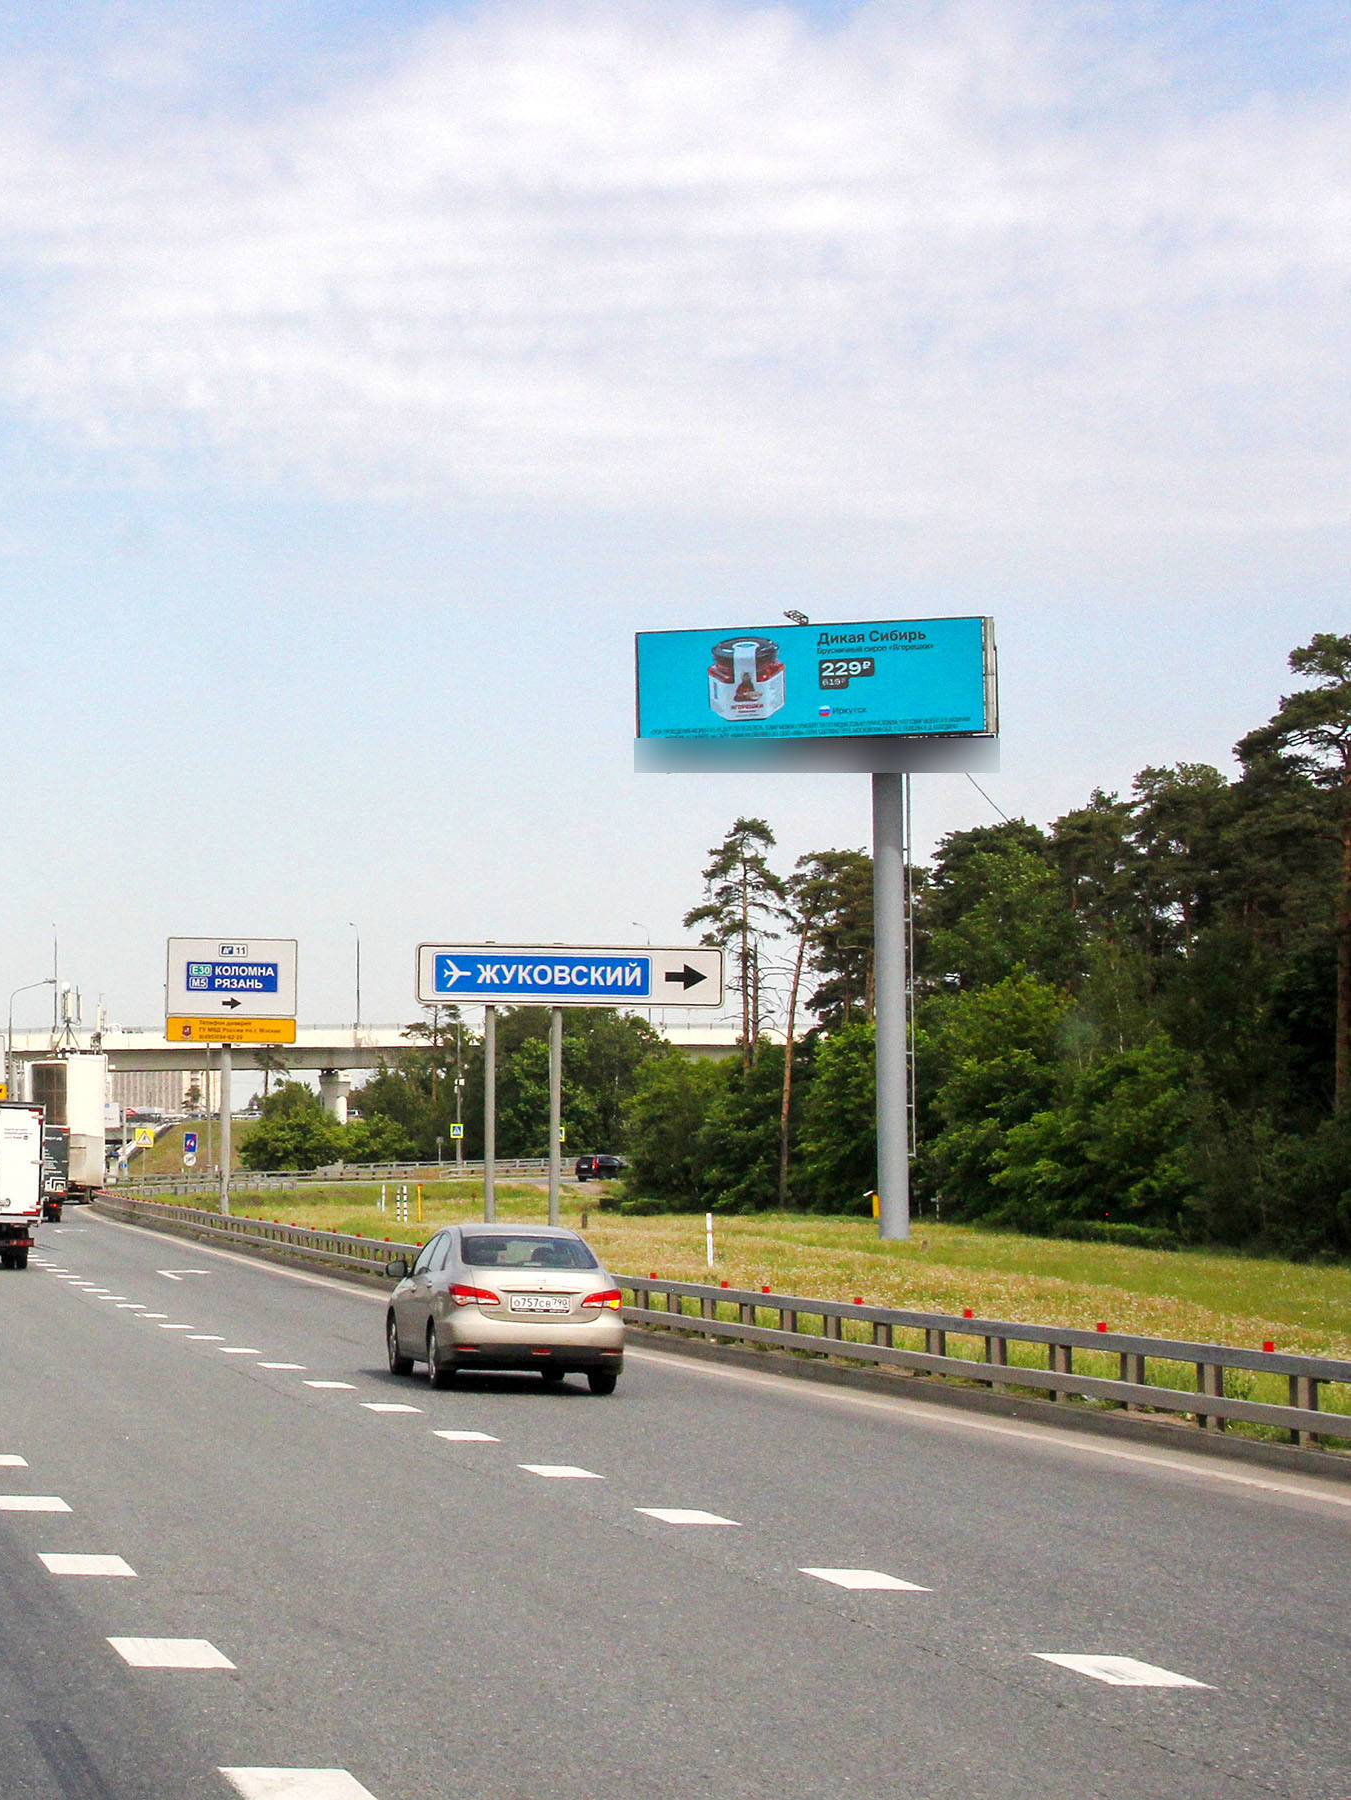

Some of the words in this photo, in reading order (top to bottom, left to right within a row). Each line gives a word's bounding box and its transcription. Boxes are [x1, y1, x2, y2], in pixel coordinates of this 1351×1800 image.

[817, 633, 865, 646] Дикая
[869, 630, 926, 643] Сибирь
[832, 706, 867, 715] Иркутск
[236, 946, 246, 955] 11
[192, 965, 211, 975] E30
[215, 965, 275, 976] КОЛОМНА
[476, 962, 642, 987] ЖУКОВСКИЙ
[214, 978, 264, 989] РЯЗАНЬ
